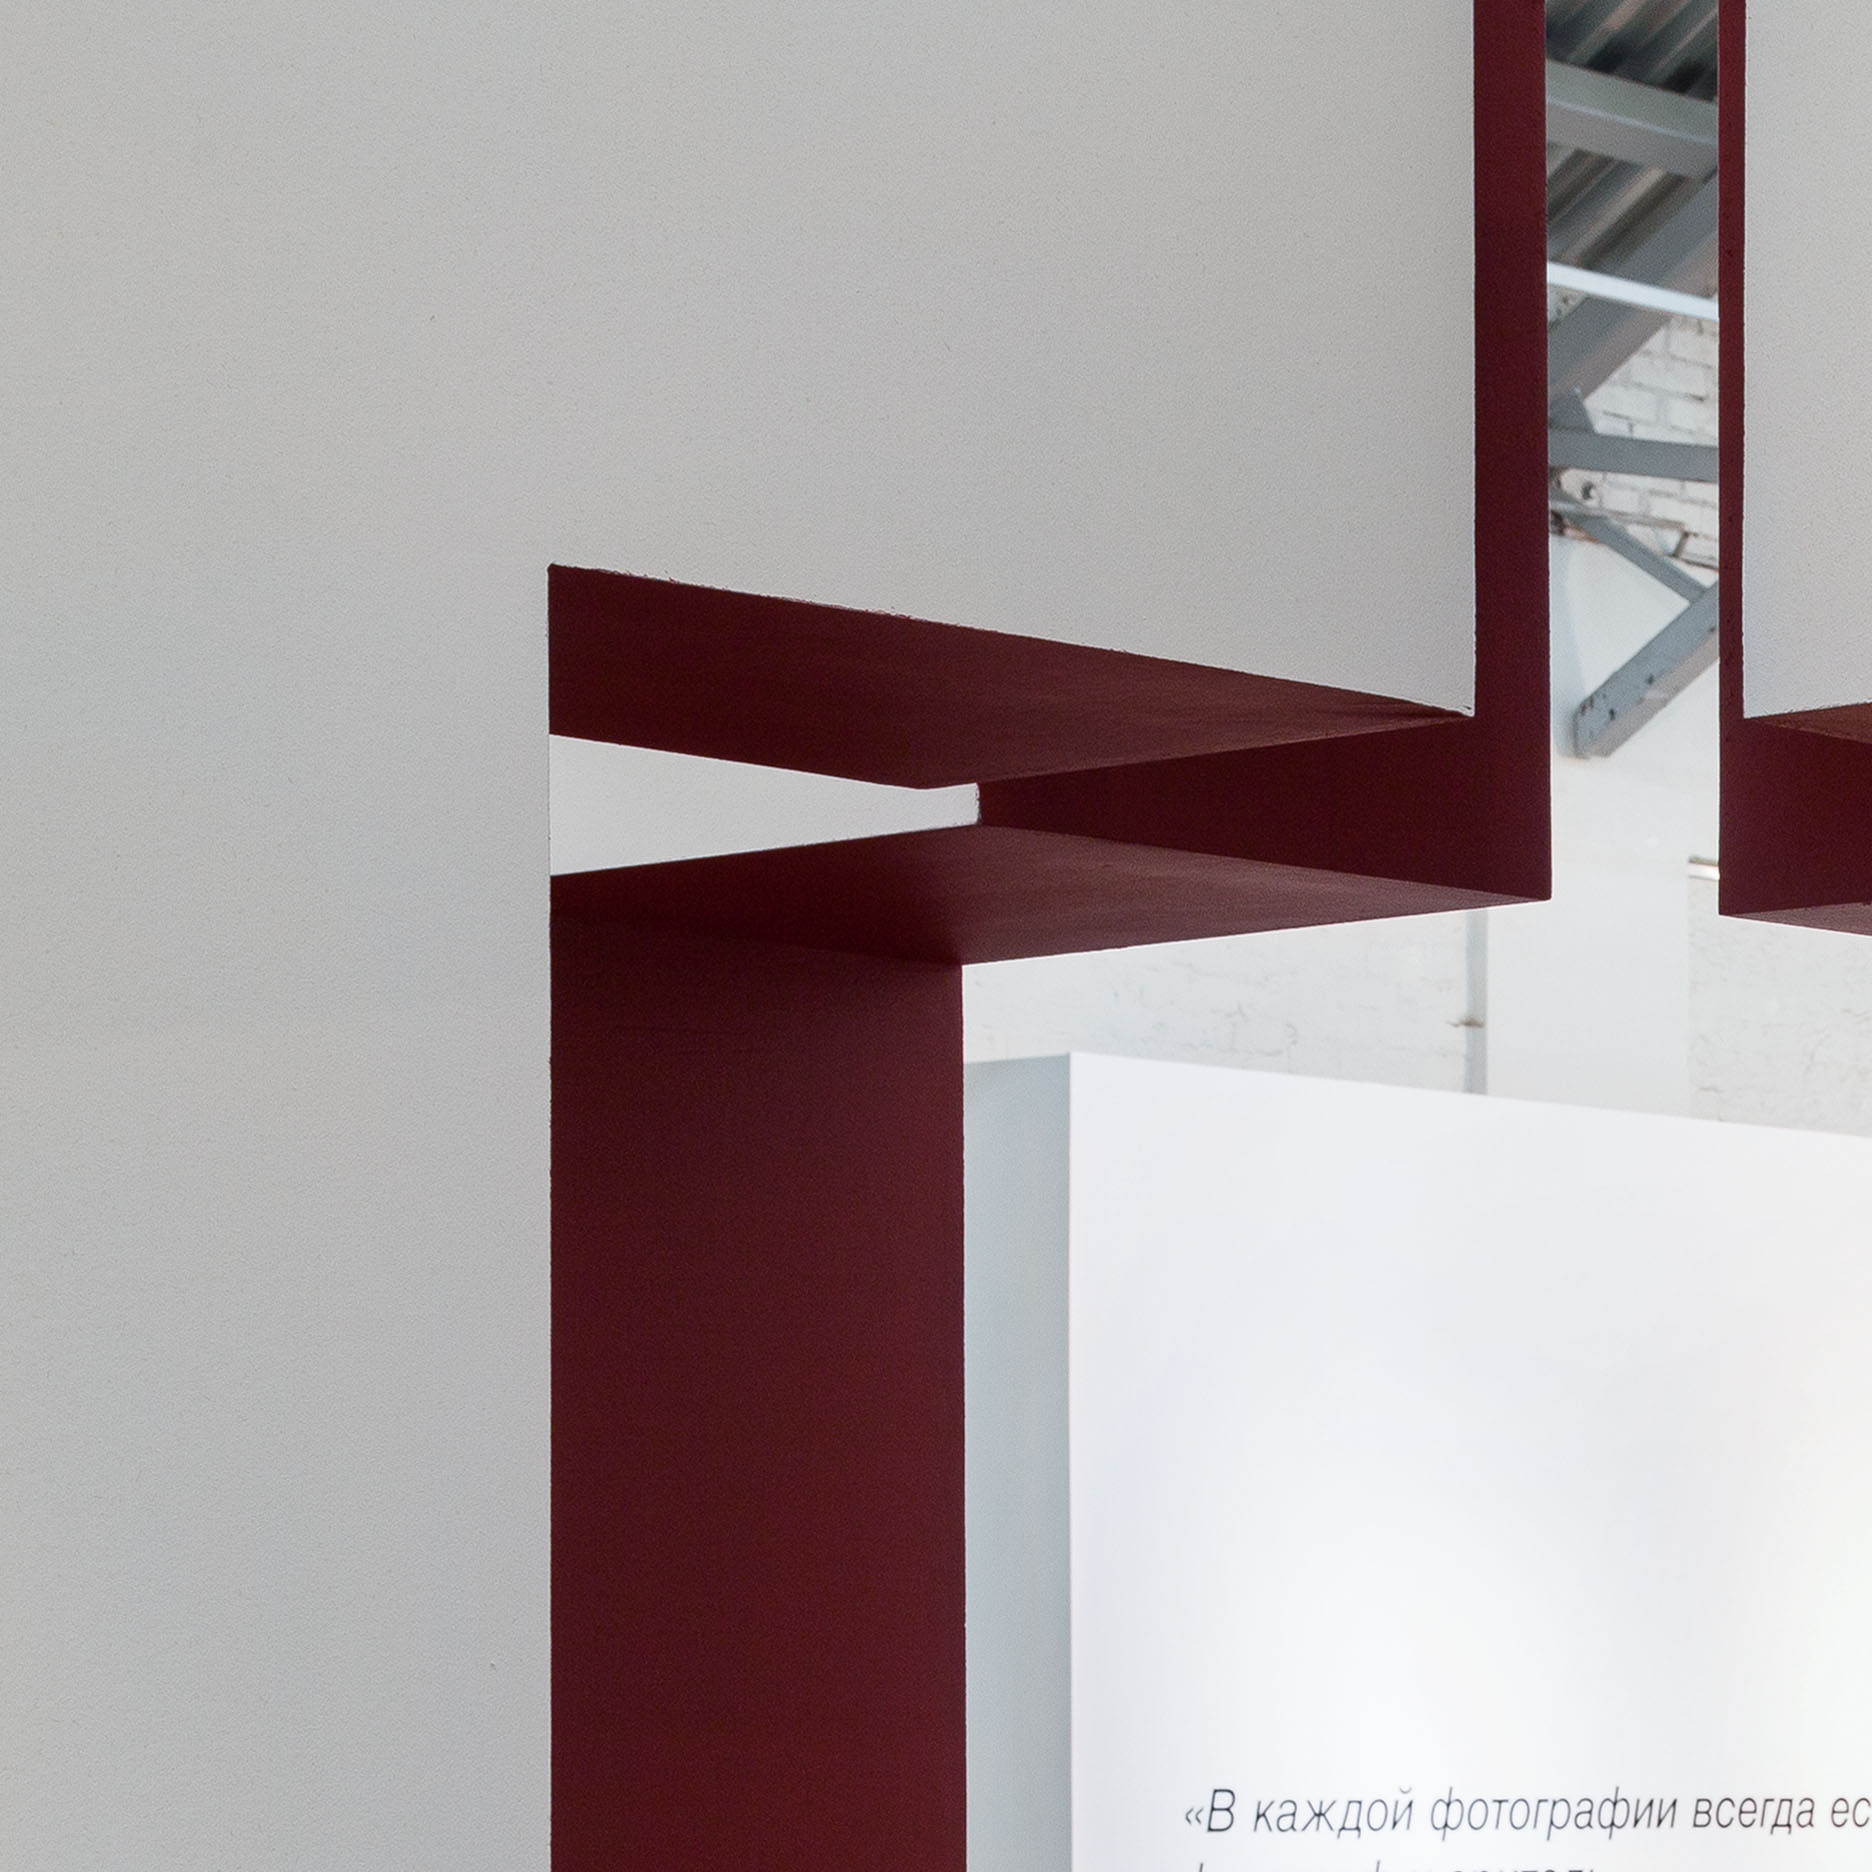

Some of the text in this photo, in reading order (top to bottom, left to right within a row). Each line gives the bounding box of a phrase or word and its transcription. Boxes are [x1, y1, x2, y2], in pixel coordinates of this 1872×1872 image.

[1184, 1788, 1235, 1832] «В
[1252, 1785, 1415, 1840] каждой
[1430, 1786, 1677, 1841] фотографии
[1692, 1797, 1814, 1835] всегда
